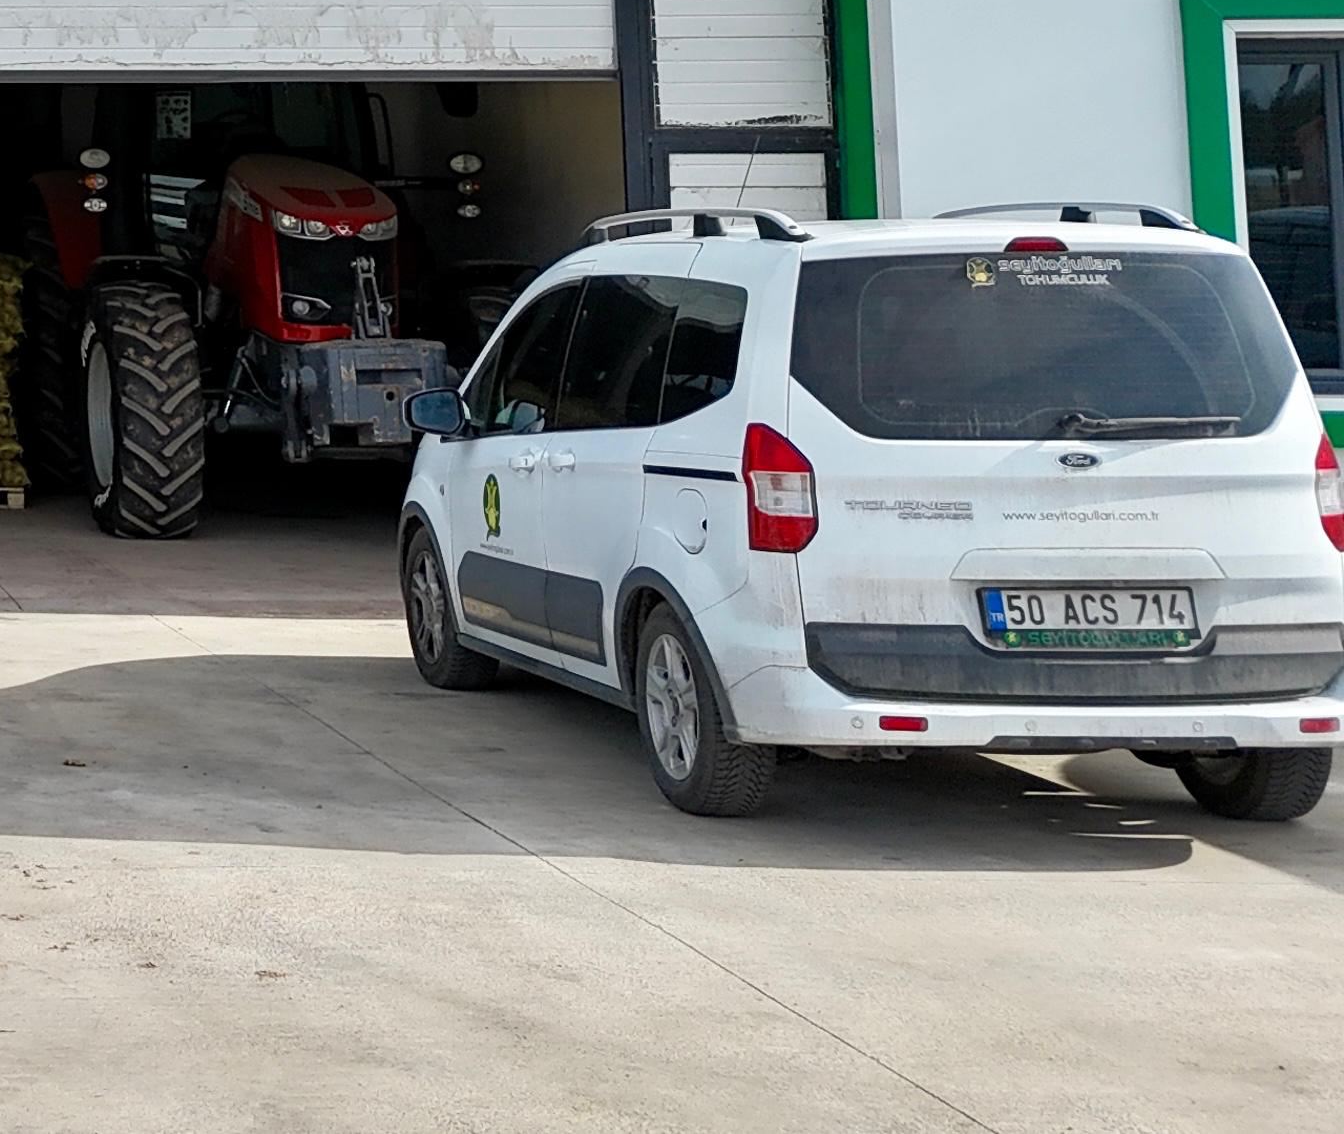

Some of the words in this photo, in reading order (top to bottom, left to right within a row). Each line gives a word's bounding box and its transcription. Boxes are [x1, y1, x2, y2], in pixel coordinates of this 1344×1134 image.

[1065, 454, 1092, 466] Ford
[844, 499, 973, 511] TOURNEO
[1006, 594, 1045, 625] 50
[1064, 594, 1119, 625] ACS
[1130, 594, 1186, 625] 714
[990, 612, 1005, 623] TR
